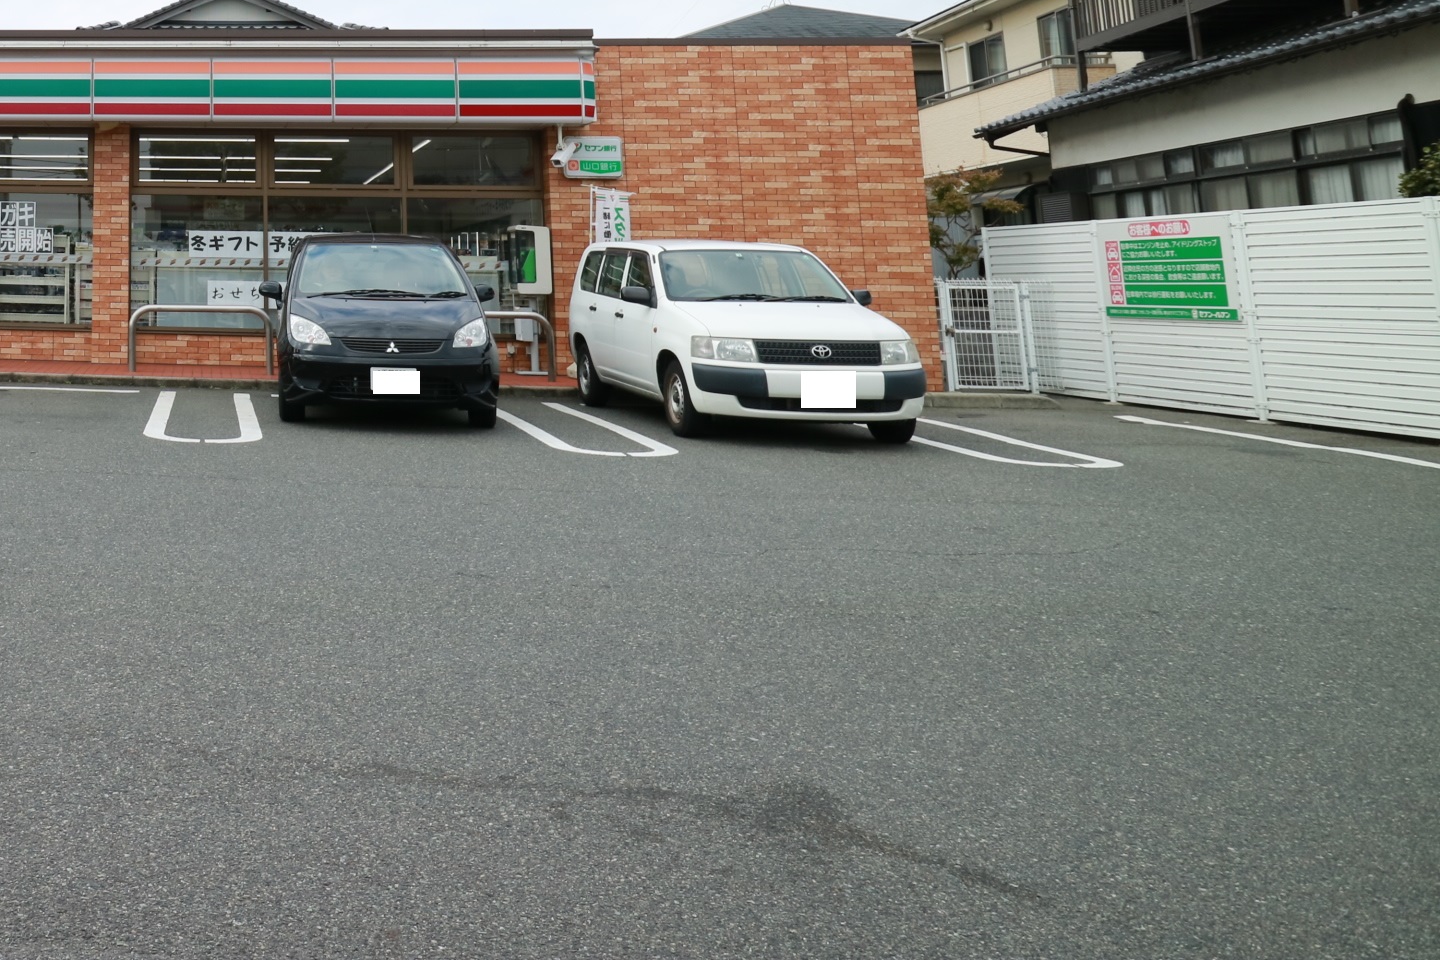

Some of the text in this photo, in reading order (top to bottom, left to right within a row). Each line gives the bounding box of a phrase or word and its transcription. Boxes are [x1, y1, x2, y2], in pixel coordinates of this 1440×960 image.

[584, 144, 617, 152] セブン銀行
[582, 162, 617, 171] 山口銀行
[191, 235, 259, 252] 冬ギフト
